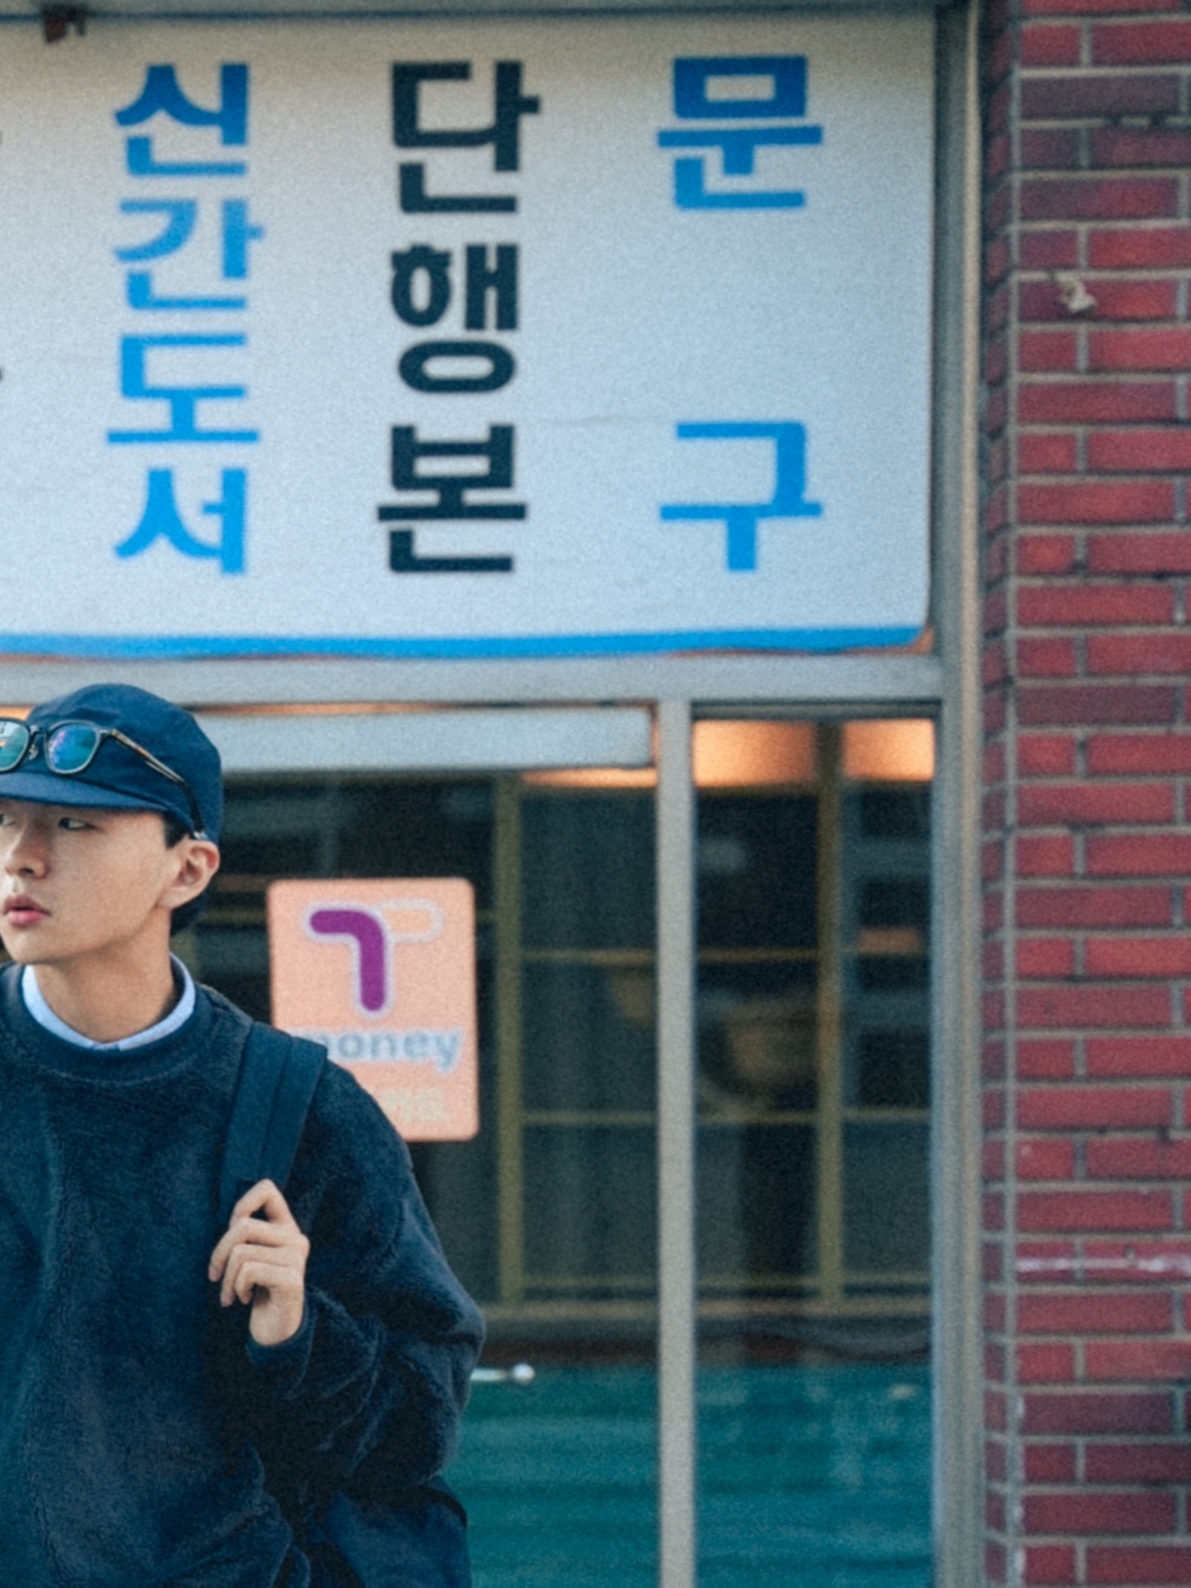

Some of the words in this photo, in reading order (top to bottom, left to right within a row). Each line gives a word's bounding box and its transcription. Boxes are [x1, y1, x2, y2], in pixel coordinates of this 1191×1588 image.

[106, 62, 264, 575] 신간도서
[376, 60, 541, 573] 단행본
[657, 54, 824, 572] 문구
[301, 1031, 462, 1072] oney
